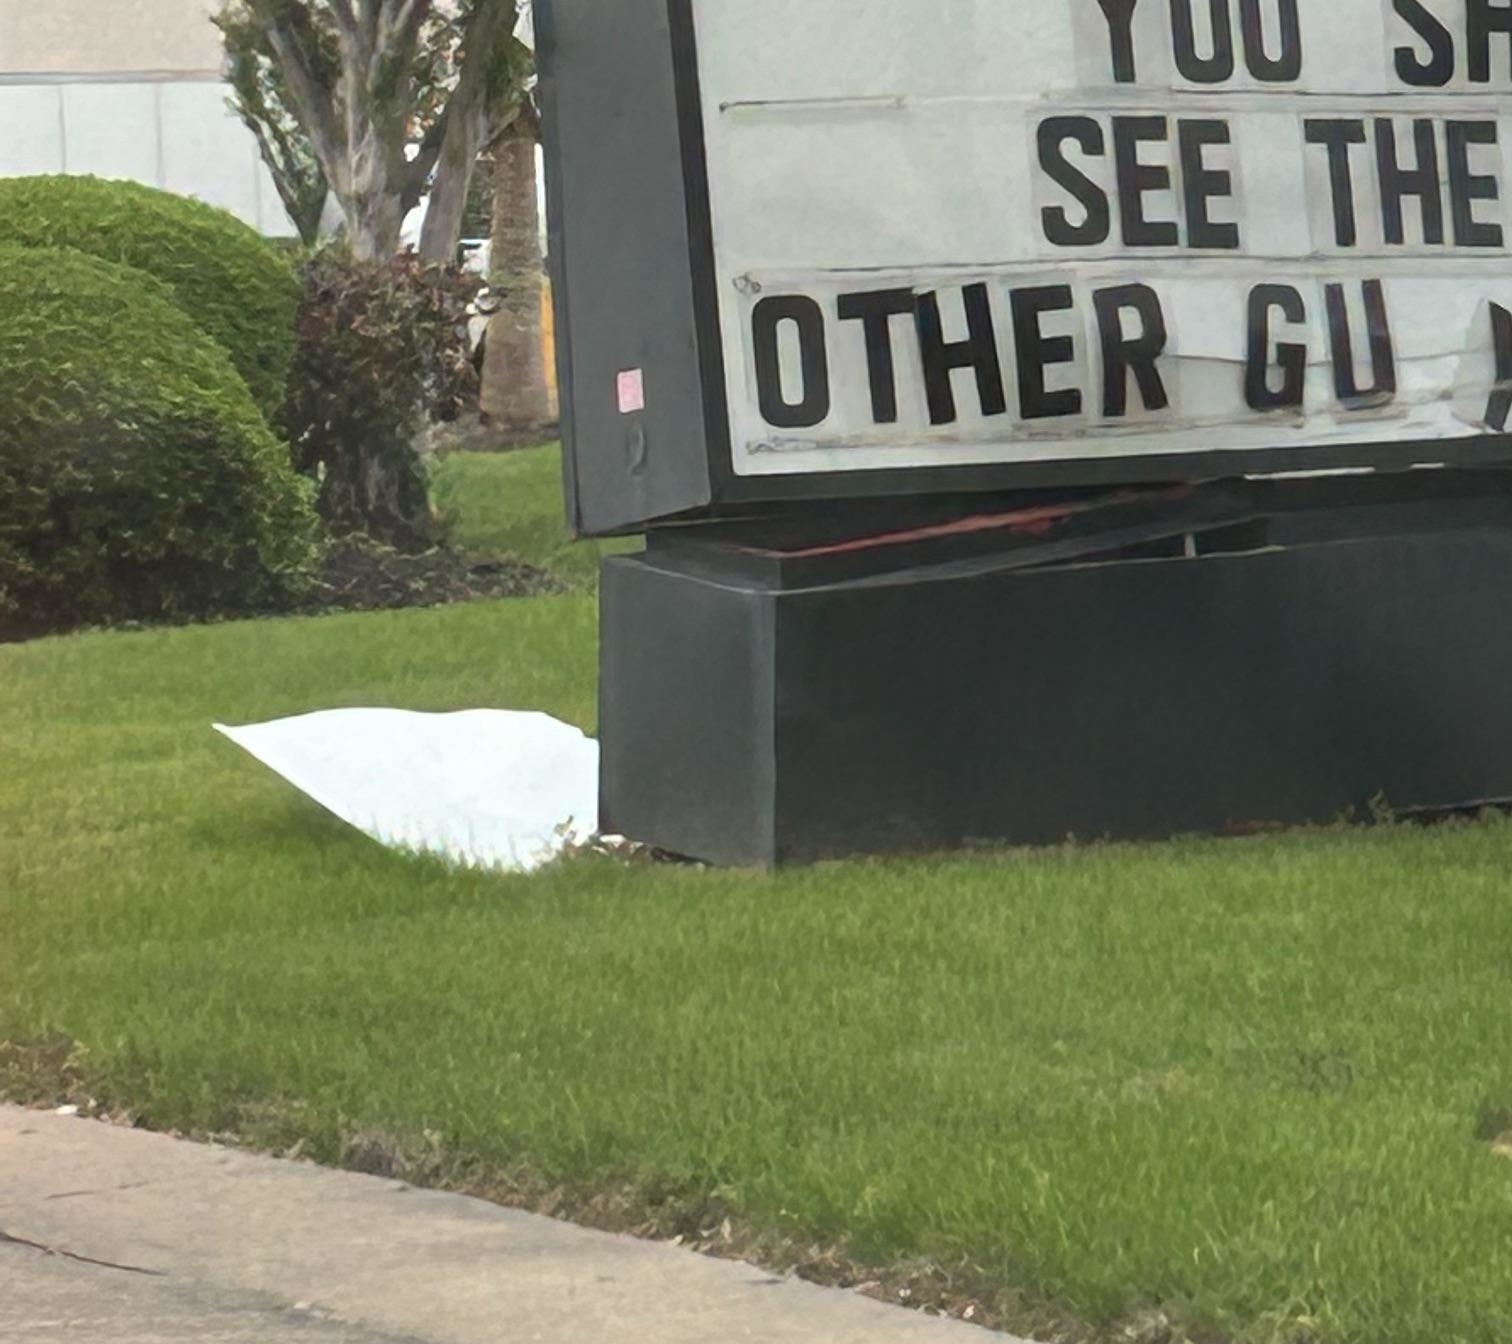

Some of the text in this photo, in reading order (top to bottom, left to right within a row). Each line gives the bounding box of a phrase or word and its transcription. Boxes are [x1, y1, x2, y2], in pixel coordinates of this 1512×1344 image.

[1037, 115, 1504, 249] SEE THE
[751, 281, 1169, 430] OTHER
